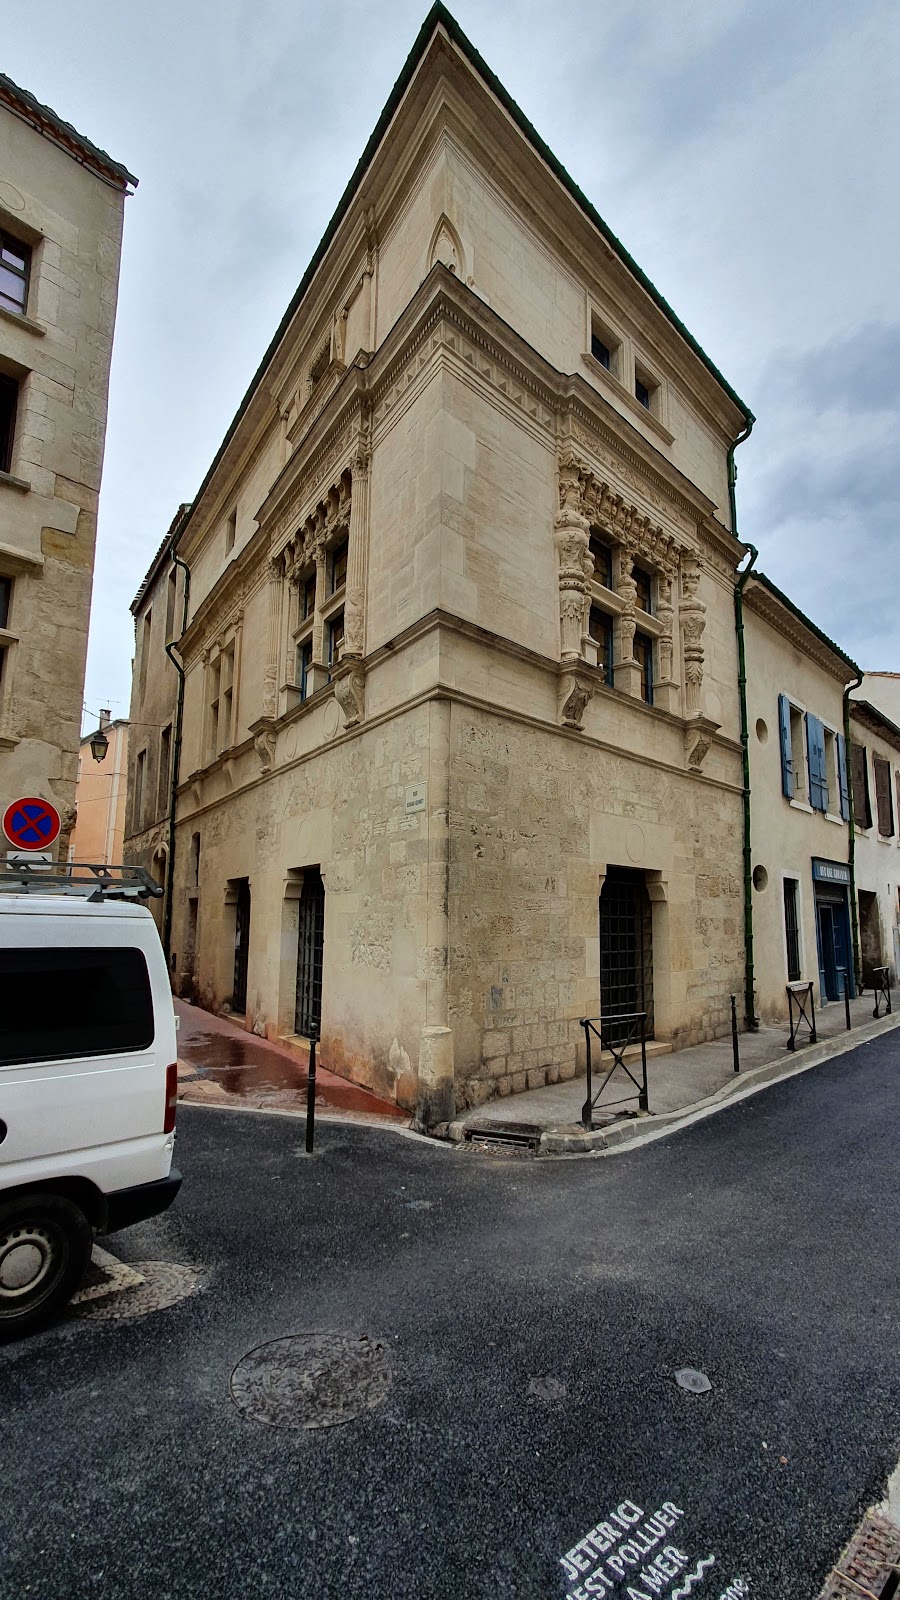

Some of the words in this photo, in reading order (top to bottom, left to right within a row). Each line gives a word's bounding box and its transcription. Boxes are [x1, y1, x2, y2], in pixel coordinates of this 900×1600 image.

[560, 1522, 622, 1580] JETER
[610, 1500, 644, 1529] ICI
[606, 1501, 685, 1575] POLLUER
[640, 1545, 688, 1593] MER
